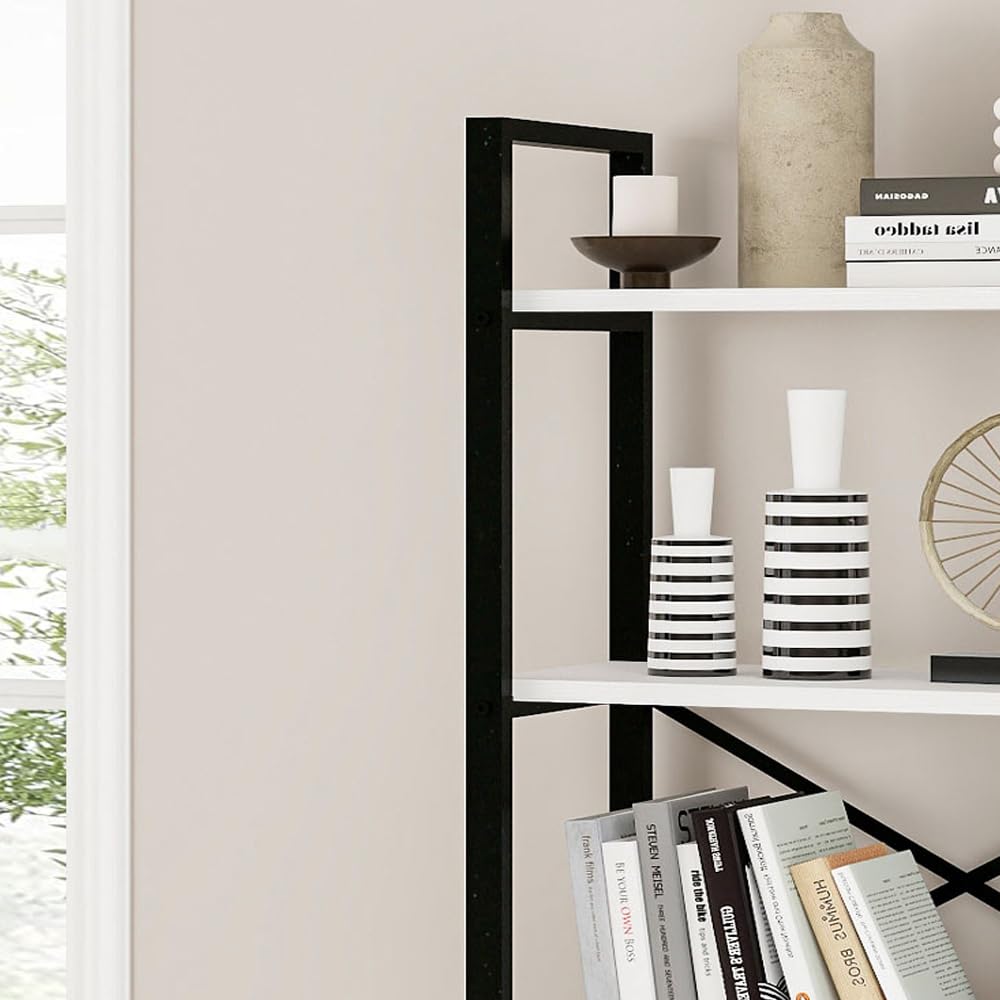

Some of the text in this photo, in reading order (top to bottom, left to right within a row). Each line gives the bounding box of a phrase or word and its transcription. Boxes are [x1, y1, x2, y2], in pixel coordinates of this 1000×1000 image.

[581, 835, 592, 858] frank
[645, 823, 659, 859] STEVEN
[584, 861, 595, 883] films
[650, 865, 664, 898] MEISEL
[690, 869, 702, 887] ride
[693, 887, 704, 902] the
[615, 862, 636, 961] BE YOUR OWN BOSS
[695, 903, 707, 922] bike
